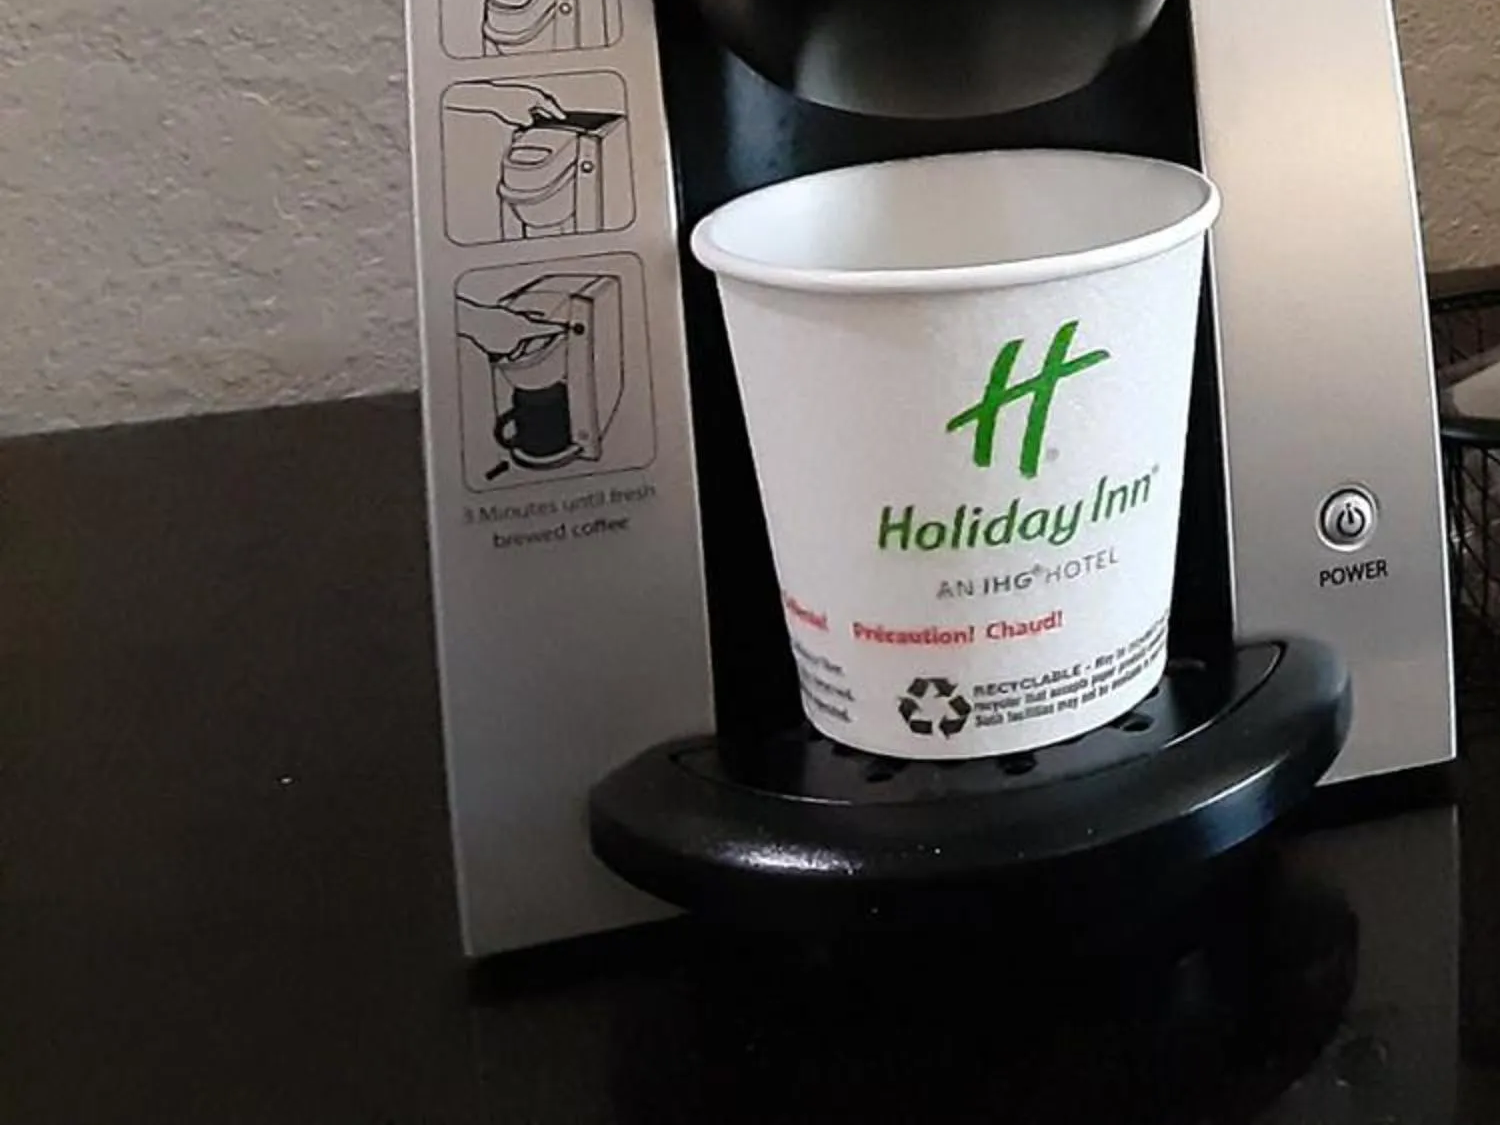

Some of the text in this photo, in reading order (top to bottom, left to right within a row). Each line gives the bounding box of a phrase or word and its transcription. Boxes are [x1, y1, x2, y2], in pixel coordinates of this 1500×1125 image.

[478, 501, 559, 524] Minutes
[561, 491, 608, 514] until
[609, 483, 657, 505] fresh
[493, 516, 631, 549] brewed coffee
[877, 497, 1085, 552] Holiday
[936, 578, 975, 600] AN
[1044, 546, 1121, 585] HOTEL
[1319, 558, 1390, 588] POWER
[986, 610, 1064, 641] Chaud!
[972, 664, 1082, 697] RECYCLABLE
